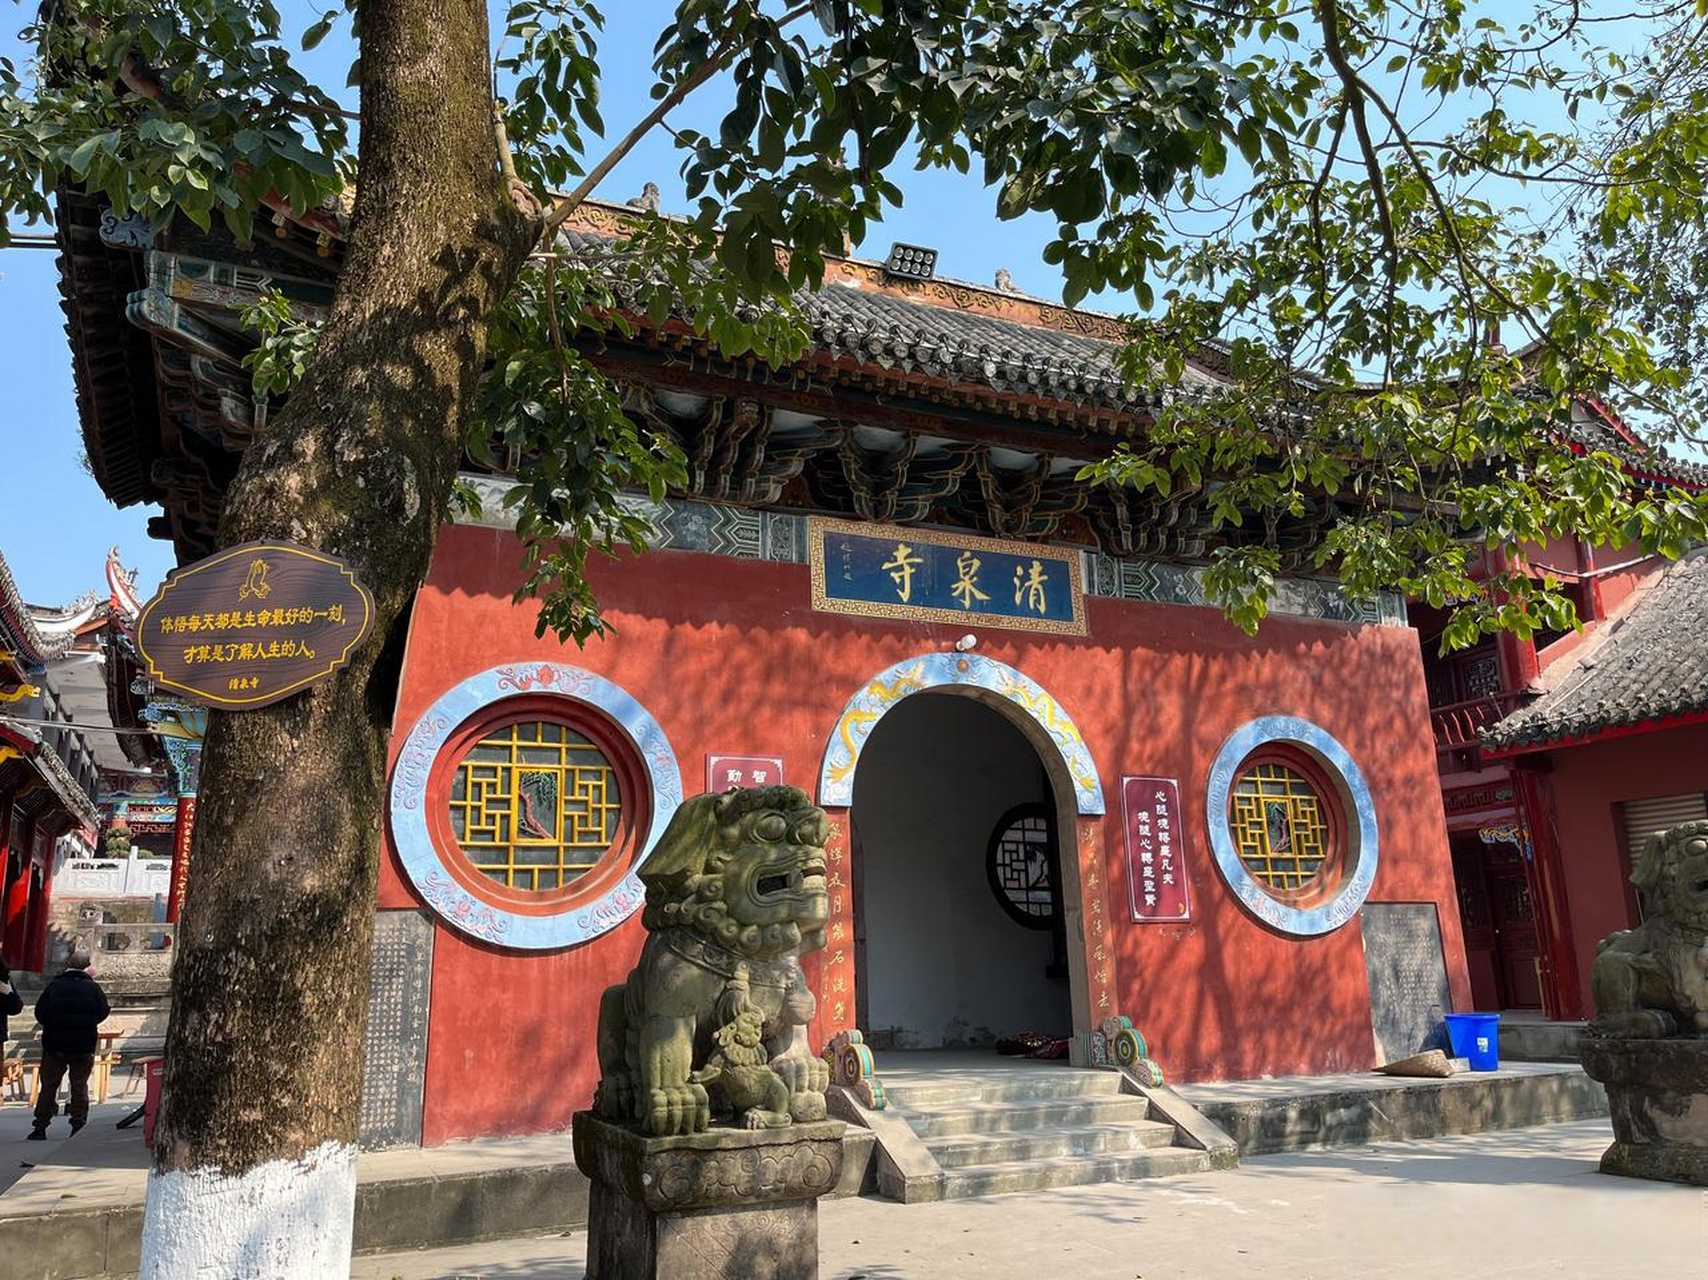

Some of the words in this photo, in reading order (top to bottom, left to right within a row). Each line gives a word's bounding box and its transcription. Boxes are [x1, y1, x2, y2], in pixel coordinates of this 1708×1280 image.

[881, 543, 1048, 614] 清泉寺
[228, 677, 259, 691] 清泉寺
